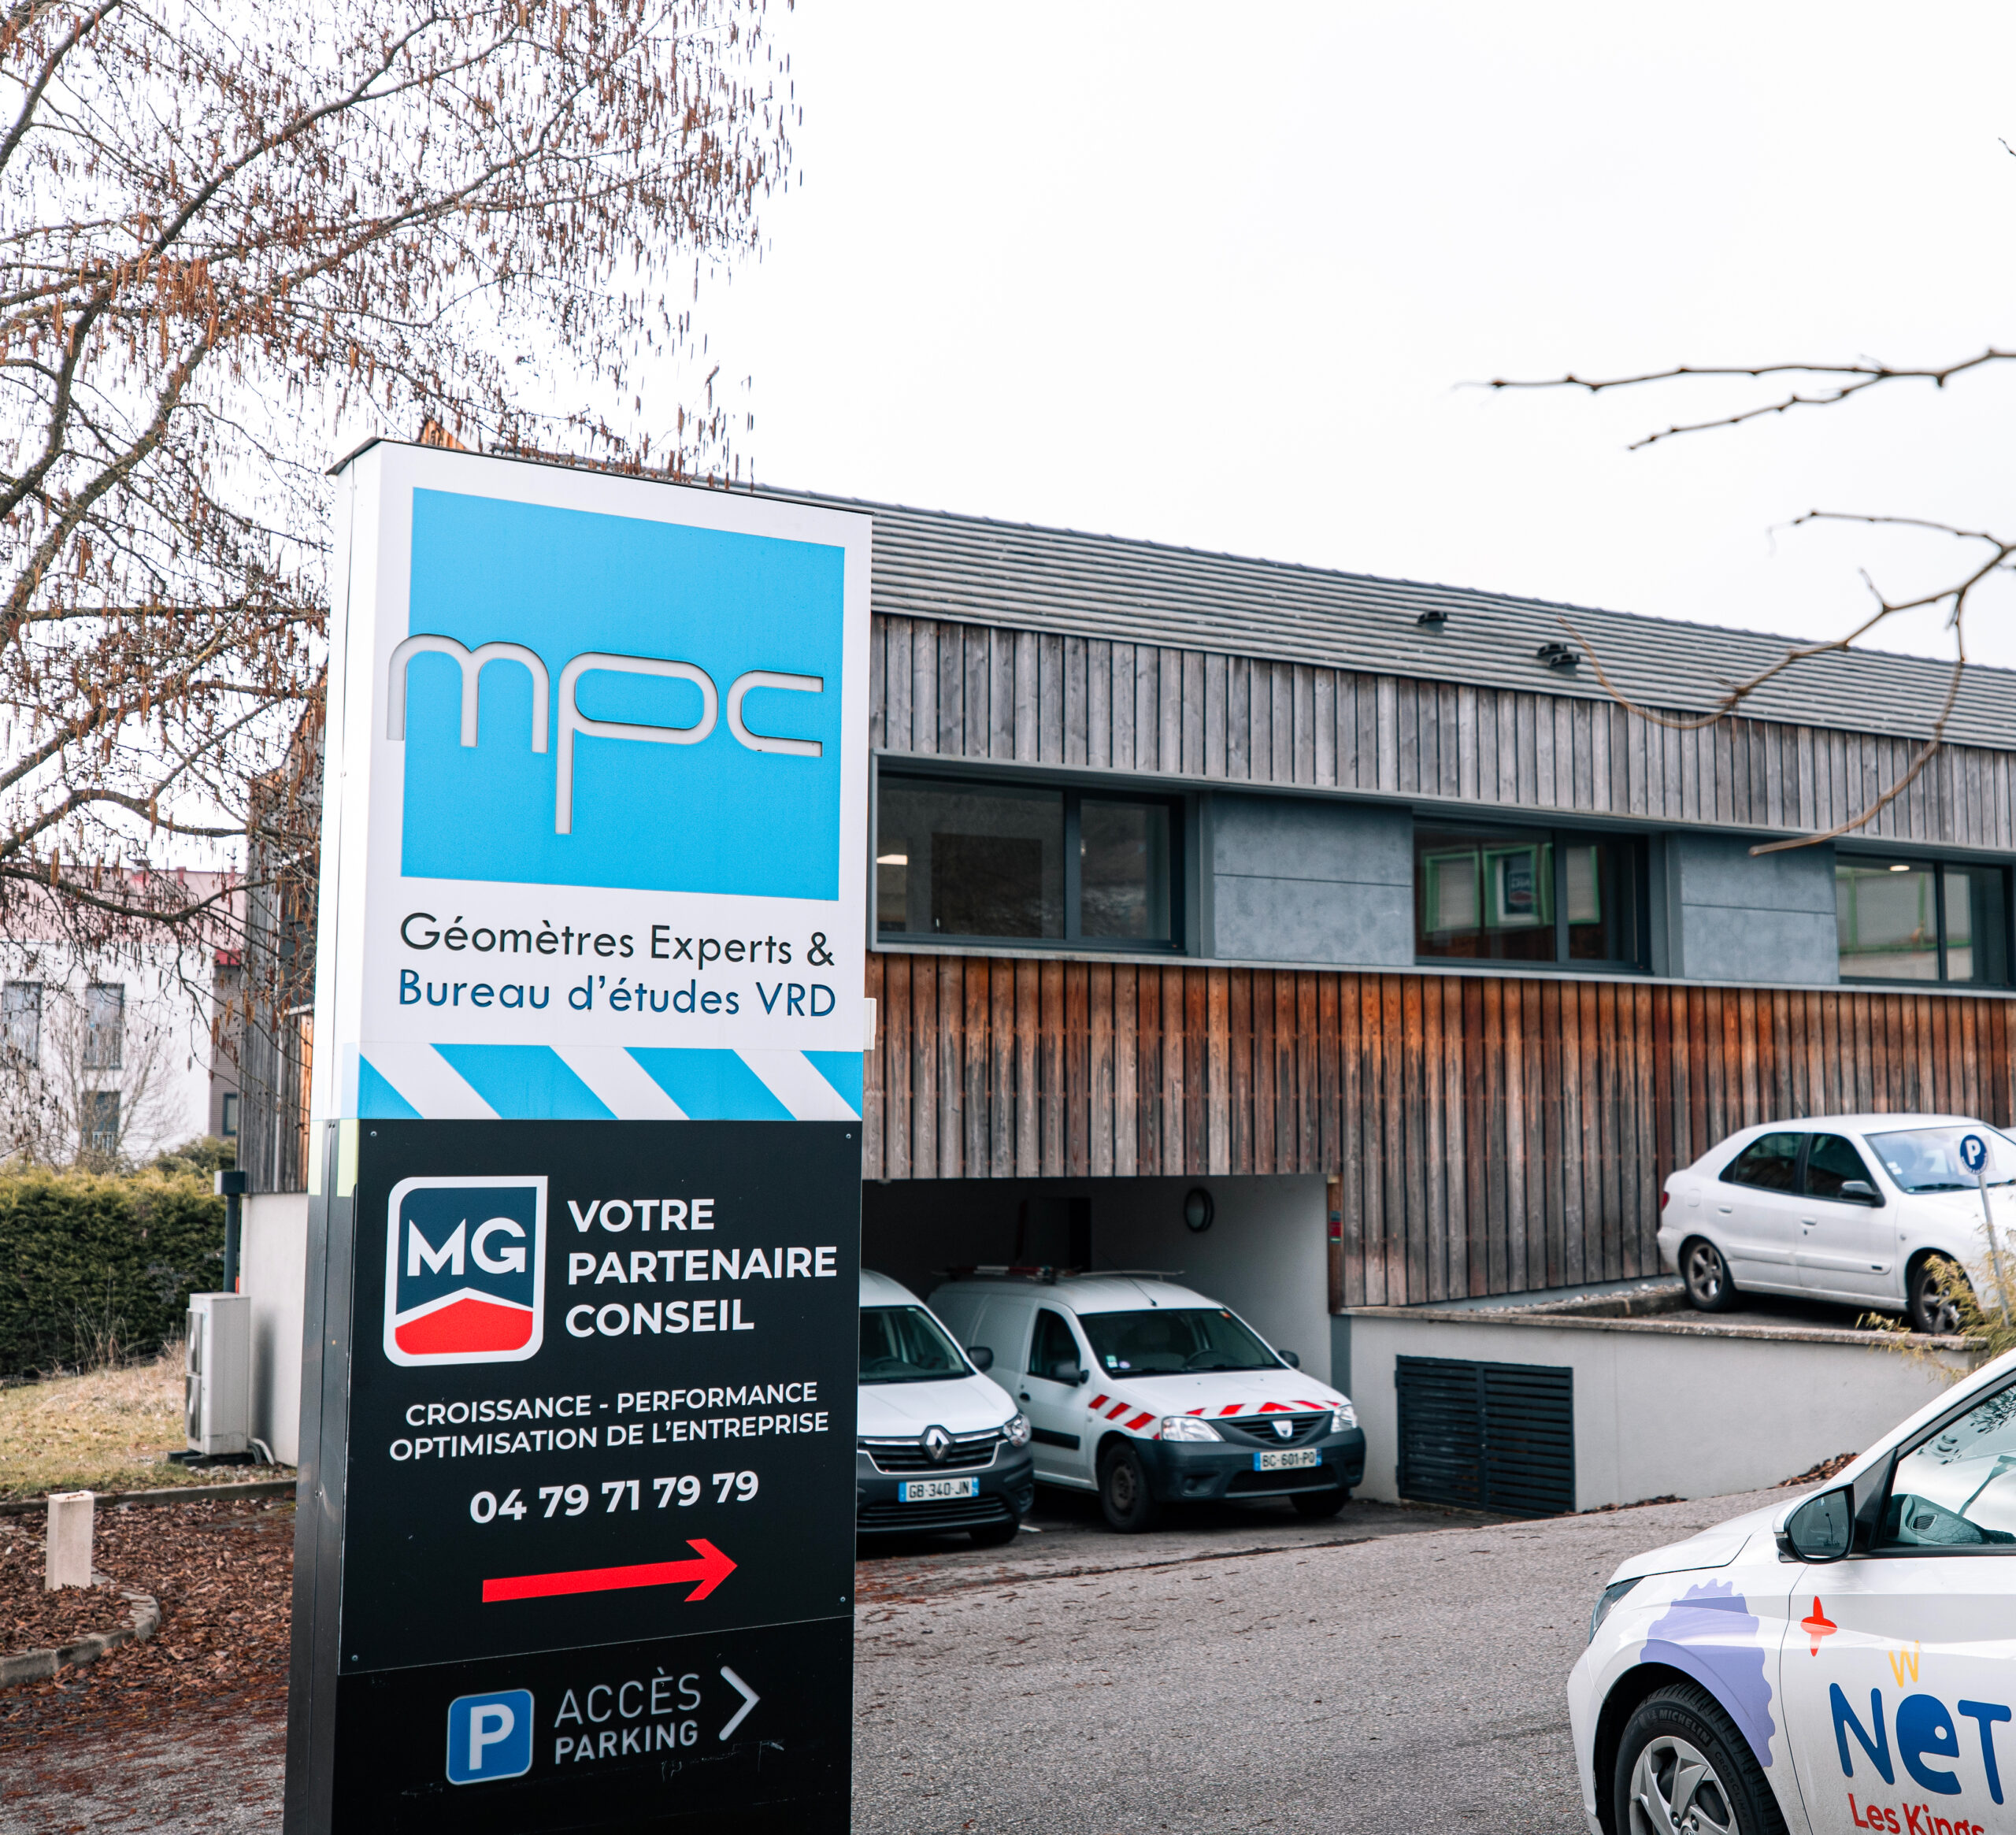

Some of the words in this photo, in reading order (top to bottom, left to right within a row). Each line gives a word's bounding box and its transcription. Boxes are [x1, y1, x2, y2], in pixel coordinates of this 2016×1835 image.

[386, 633, 824, 835] mpc
[400, 912, 634, 959] Géomètres
[650, 924, 792, 970] Experts
[806, 931, 836, 967] &
[398, 969, 550, 1010] Bureau
[568, 974, 739, 1015] d’études
[755, 981, 836, 1017] VRD
[567, 1198, 715, 1233] VOTRE
[406, 1217, 526, 1277] MG
[568, 1246, 838, 1285] PARTENAIRE
[565, 1299, 755, 1338] CONSEIL
[406, 1395, 591, 1426] CROISSANCE
[617, 1381, 817, 1414] PERFORMANCE
[389, 1427, 598, 1461] OPTIMISATION
[606, 1423, 644, 1447] DE
[652, 1411, 829, 1444] L’ENTREPRISE
[469, 1488, 528, 1524] 04
[539, 1484, 589, 1518] 79
[601, 1479, 639, 1513] 71
[653, 1475, 701, 1508] 79
[712, 1470, 759, 1503] 79
[1888, 1639, 1921, 1689] W
[554, 1666, 701, 1728] ACCÈS
[469, 1703, 515, 1770] P
[554, 1719, 699, 1765] PARKING
[1659, 1709, 1711, 1743] MICHELIN
[1847, 1792, 1901, 1834] Les
